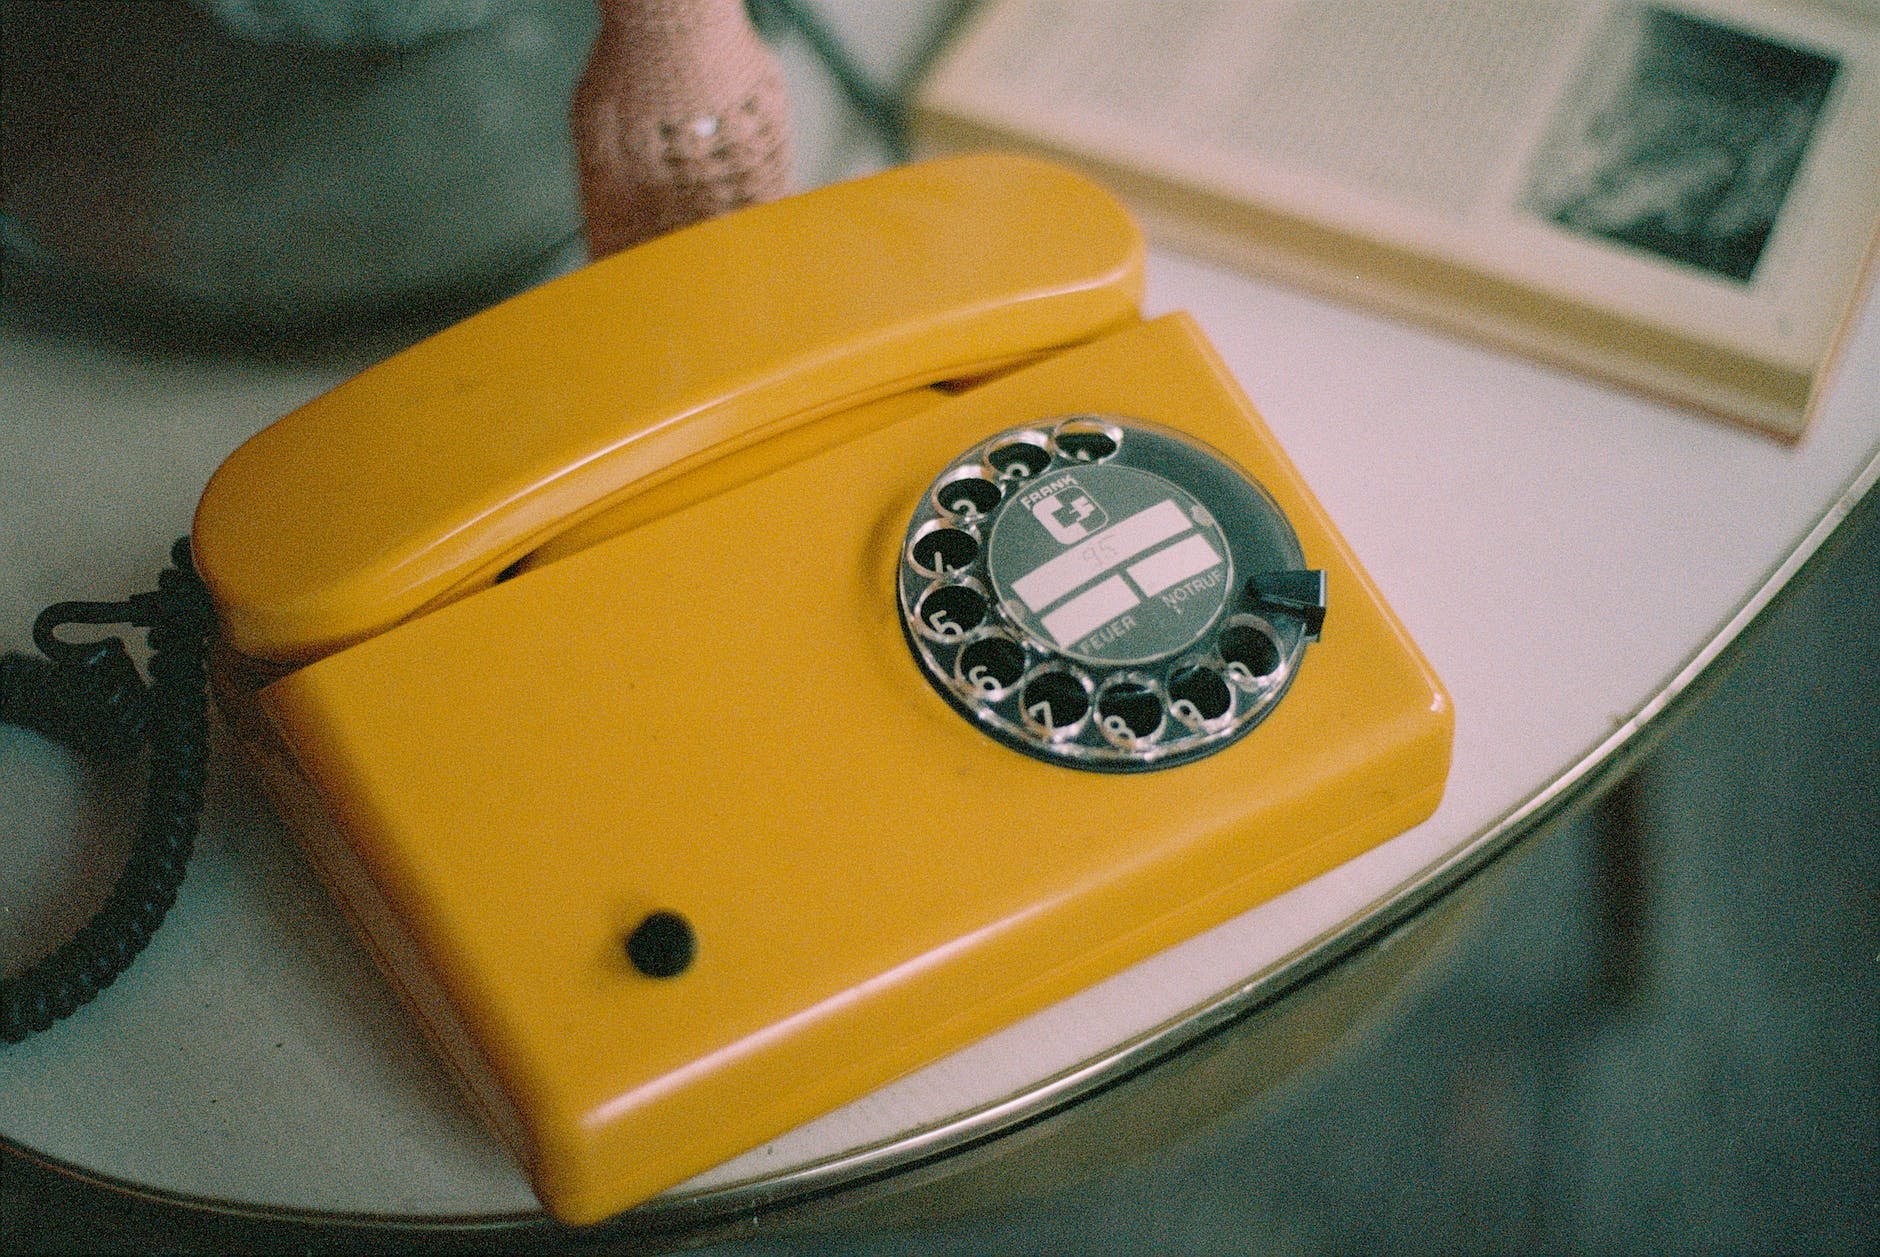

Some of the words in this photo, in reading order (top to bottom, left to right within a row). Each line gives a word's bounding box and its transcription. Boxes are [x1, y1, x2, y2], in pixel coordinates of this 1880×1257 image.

[1020, 475, 1079, 511] FRANK
[1161, 569, 1223, 608] NOTRUF
[929, 609, 964, 638] 5
[1080, 615, 1138, 656] FEUER
[968, 665, 1002, 696] 6
[1027, 700, 1055, 733] 7
[1103, 714, 1138, 748] 8
[1170, 699, 1206, 737] 9
